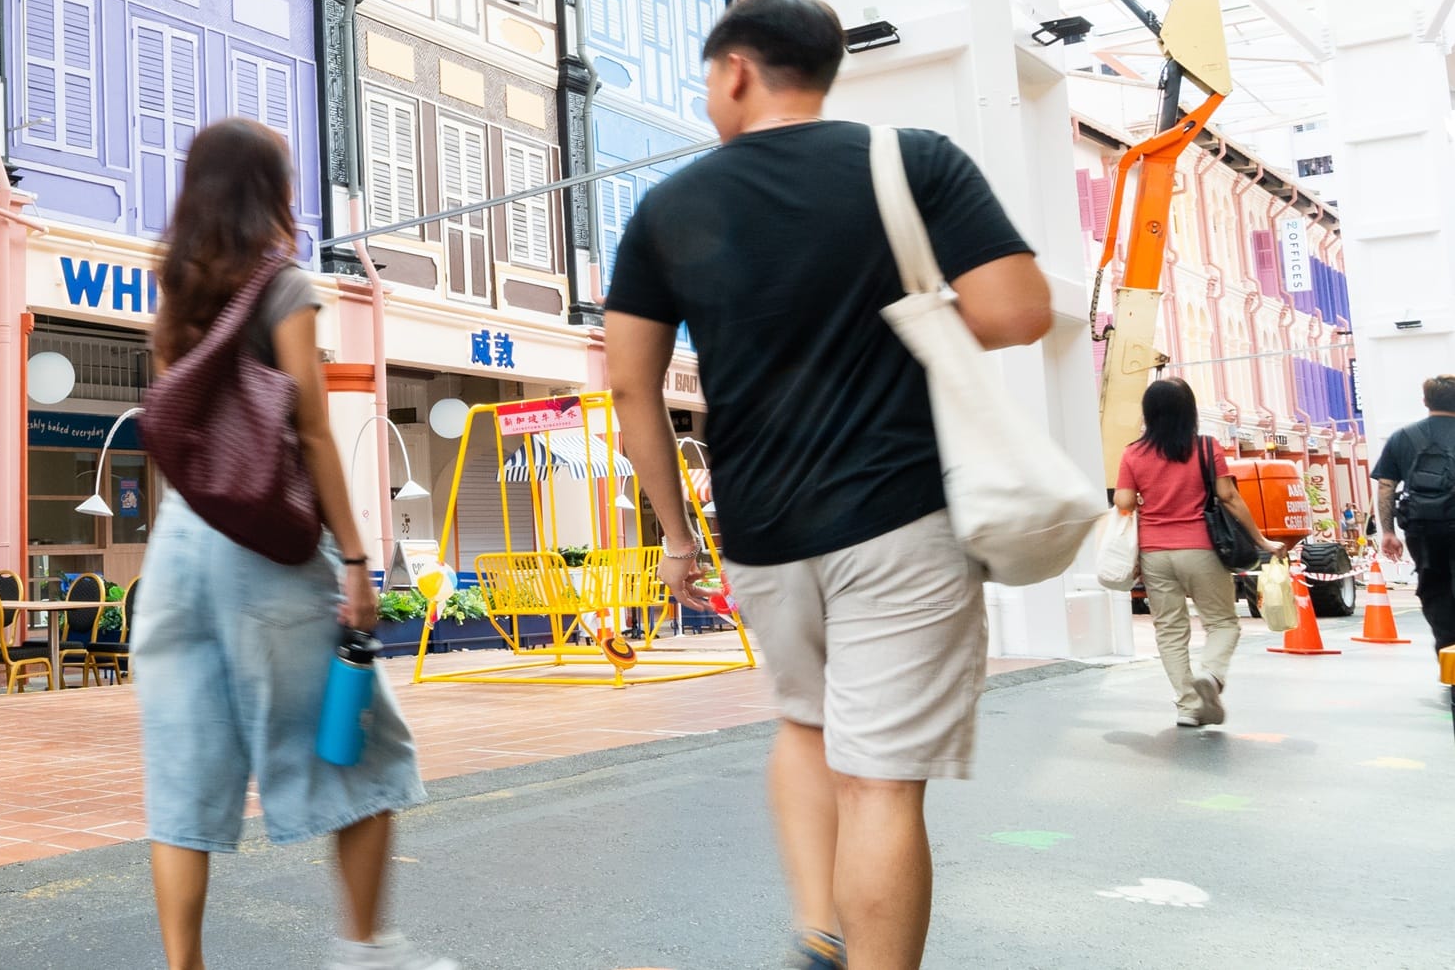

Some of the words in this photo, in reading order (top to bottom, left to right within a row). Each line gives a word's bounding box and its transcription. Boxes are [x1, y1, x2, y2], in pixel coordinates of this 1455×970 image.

[1289, 233, 1303, 288] OFFICES
[48, 420, 69, 435] baked
[71, 426, 104, 441] everyday
